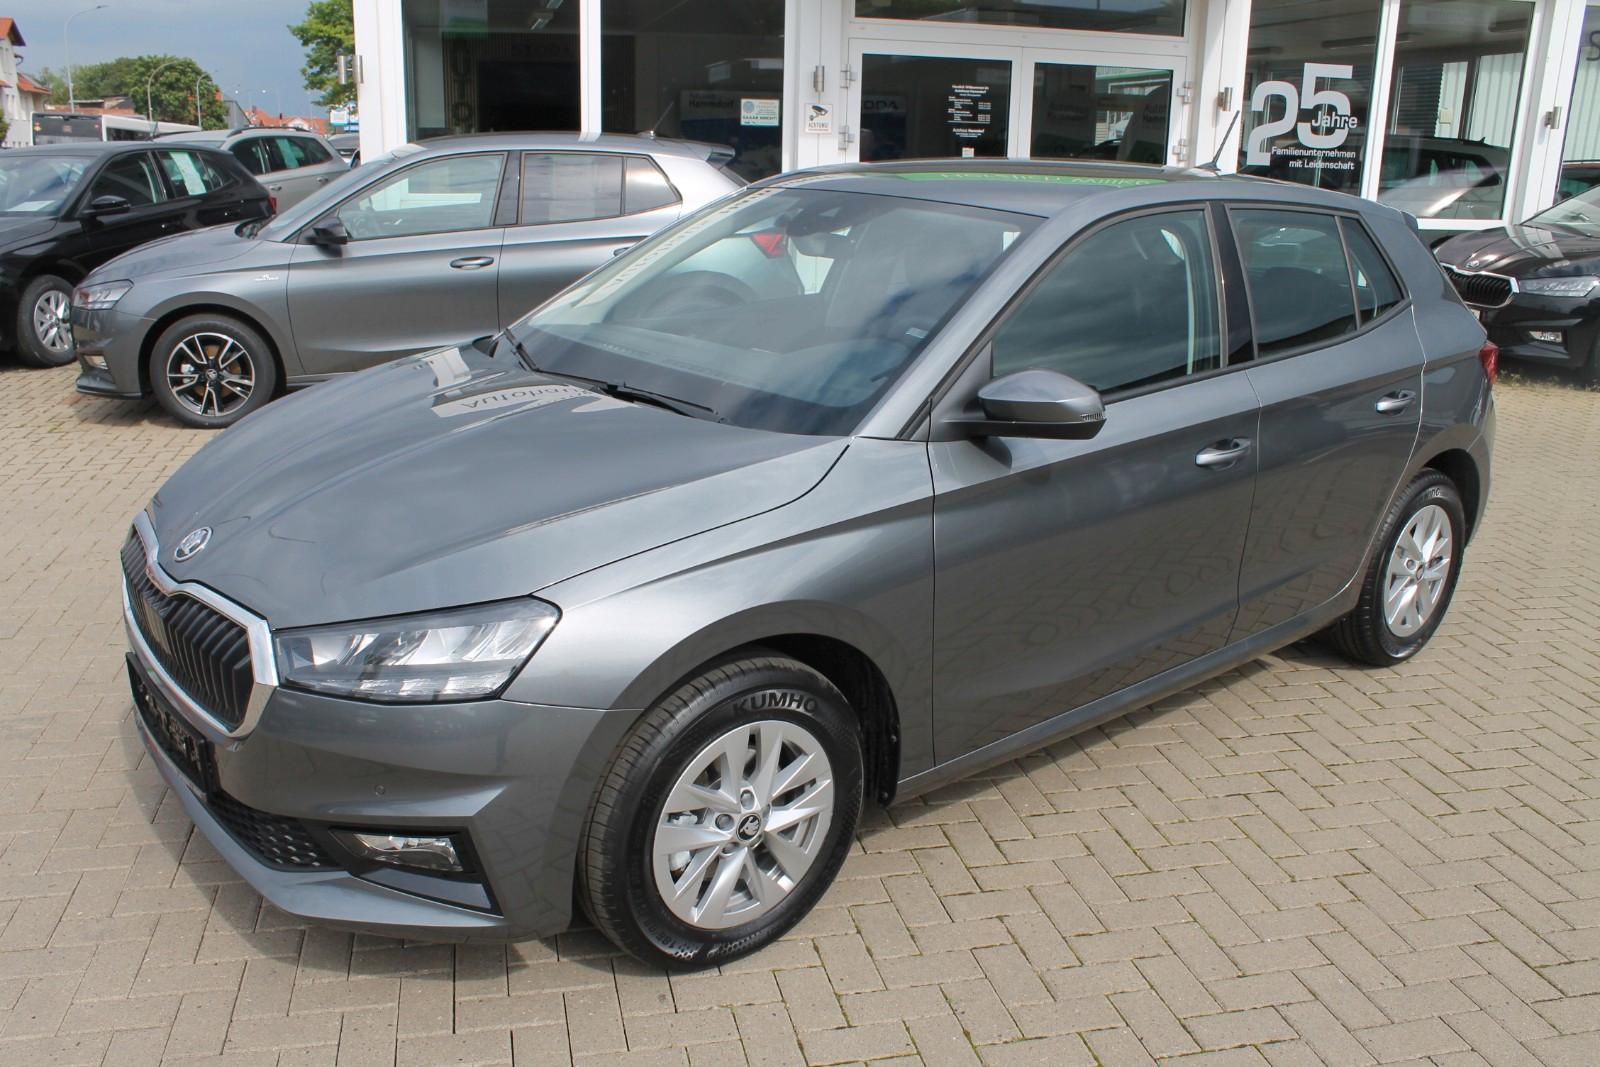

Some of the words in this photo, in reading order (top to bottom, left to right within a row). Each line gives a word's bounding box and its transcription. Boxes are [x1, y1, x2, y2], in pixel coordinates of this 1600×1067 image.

[1247, 63, 1353, 166] 25
[1311, 111, 1358, 129] Jahre
[1271, 146, 1356, 158] Familienunternehmen
[1289, 159, 1303, 168] mit
[1304, 159, 1356, 170] Leidenschaft
[733, 692, 818, 717] KUMHO
